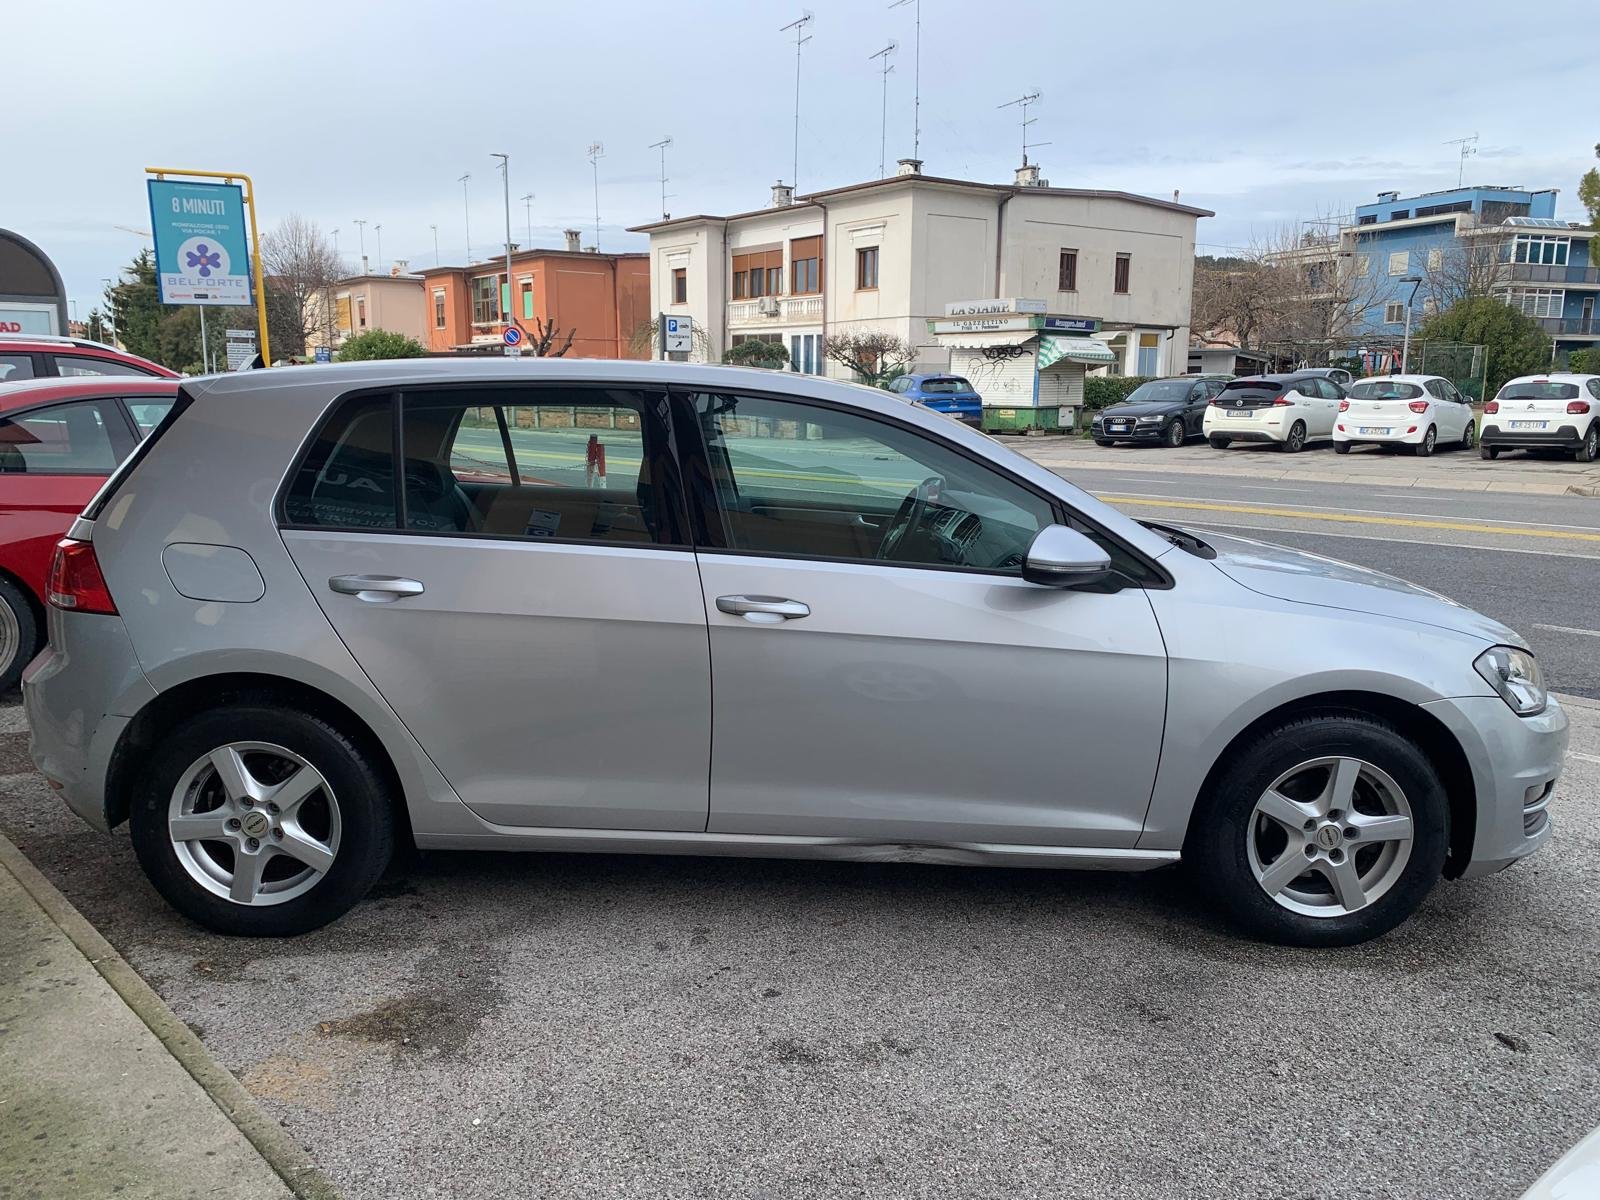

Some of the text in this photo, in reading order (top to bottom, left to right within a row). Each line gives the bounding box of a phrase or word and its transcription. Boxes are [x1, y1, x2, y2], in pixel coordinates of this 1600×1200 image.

[171, 197, 225, 215] 8 MINUTI
[168, 277, 243, 287] BELFORTE
[951, 306, 966, 315] LA
[963, 319, 1009, 327] GAZZETTINO
